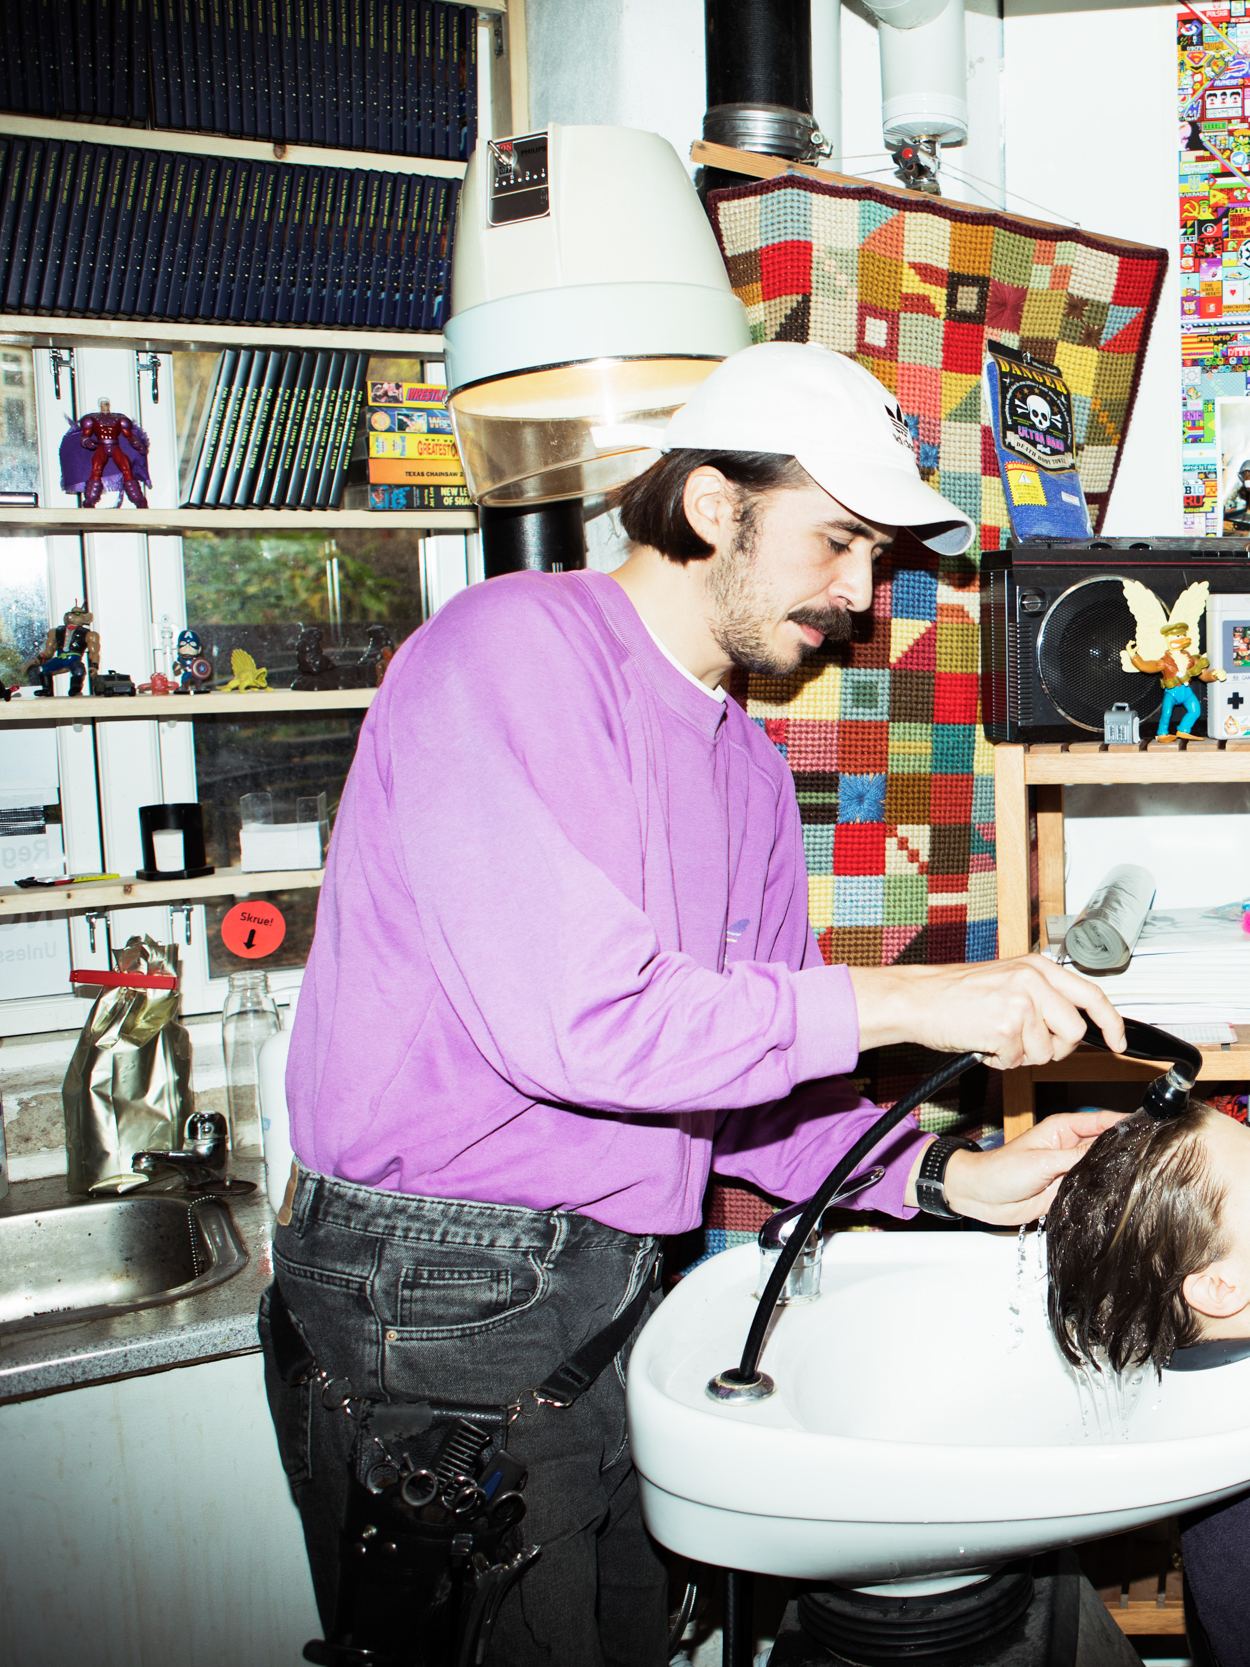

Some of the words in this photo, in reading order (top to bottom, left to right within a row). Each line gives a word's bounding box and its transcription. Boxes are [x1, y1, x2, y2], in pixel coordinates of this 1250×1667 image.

[1206, 109, 1242, 118] BABYMETAL
[521, 146, 547, 156] PHILIPS
[998, 358, 1067, 394] DANGER
[1018, 426, 1045, 444] ULTRA
[417, 440, 451, 457] GREATEST
[441, 487, 458, 496] NEW
[444, 497, 453, 505] OF
[1184, 496, 1203, 506] RU
[239, 910, 275, 928] Skrue!
